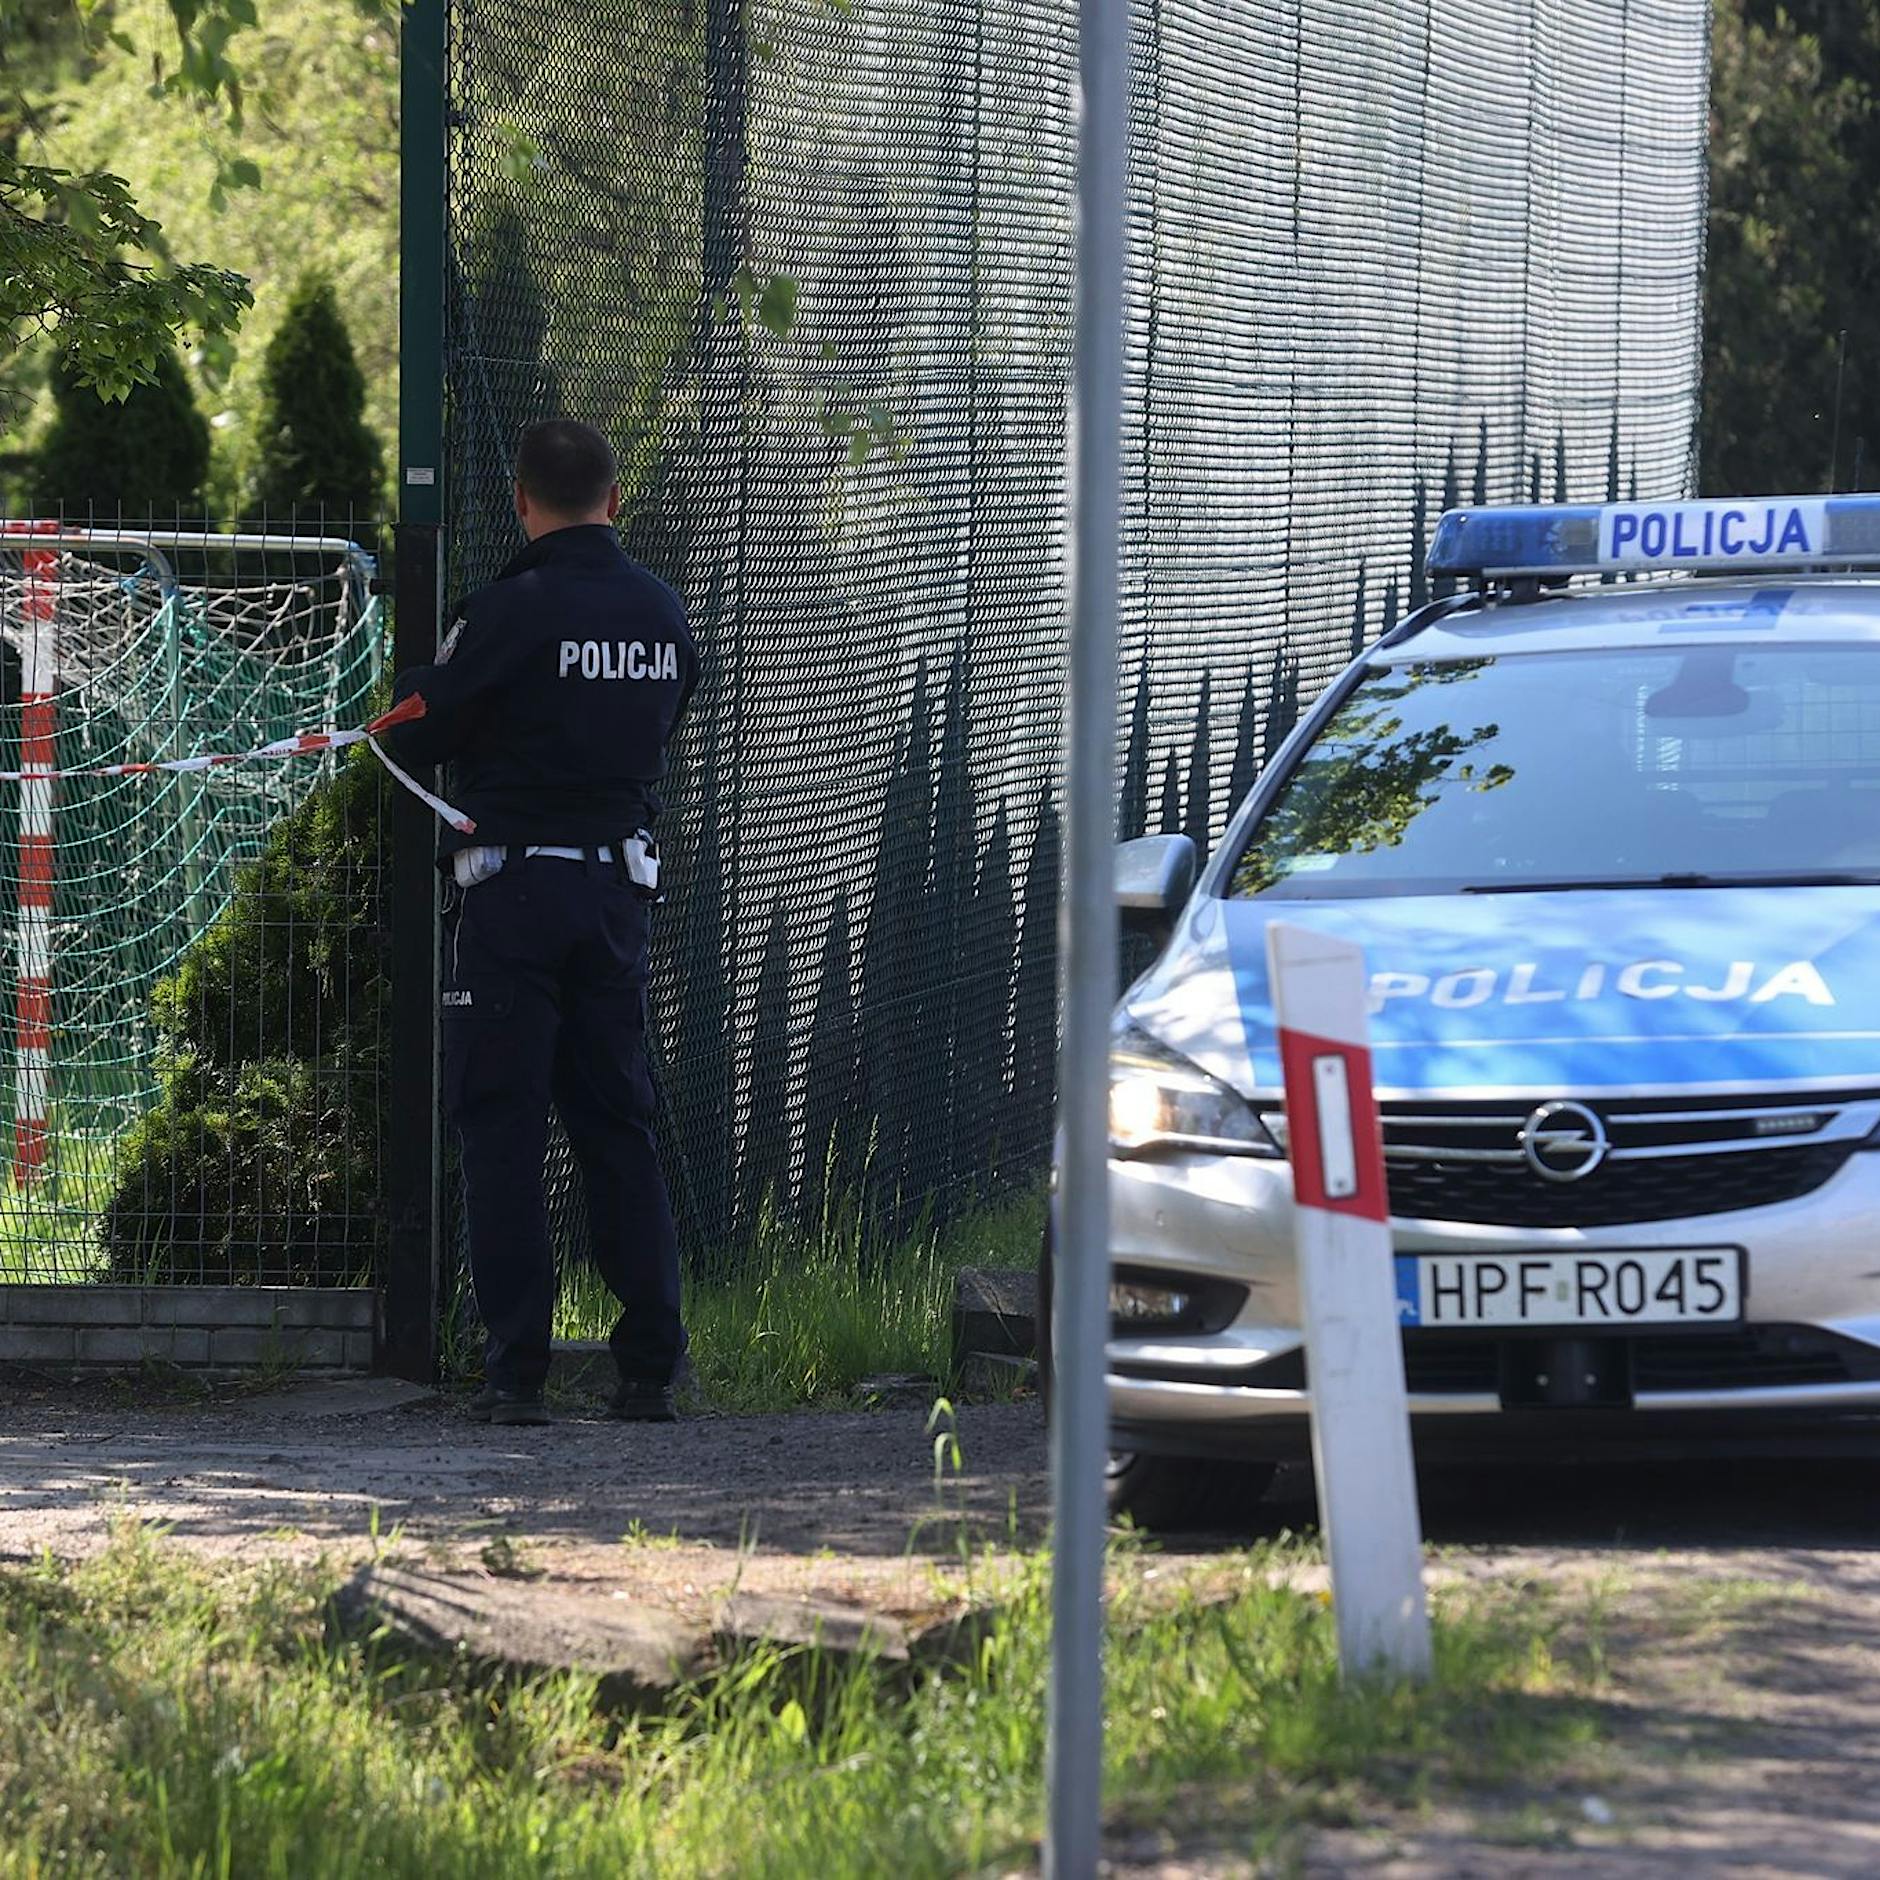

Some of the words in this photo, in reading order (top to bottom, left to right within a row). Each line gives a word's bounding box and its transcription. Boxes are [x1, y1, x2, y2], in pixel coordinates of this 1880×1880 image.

[1611, 507, 1810, 559] POLICJA
[559, 640, 678, 680] POLICJA
[1366, 960, 1836, 1014] POLICJA
[1431, 1262, 1553, 1320] HPF
[1575, 1258, 1726, 1318] R045
